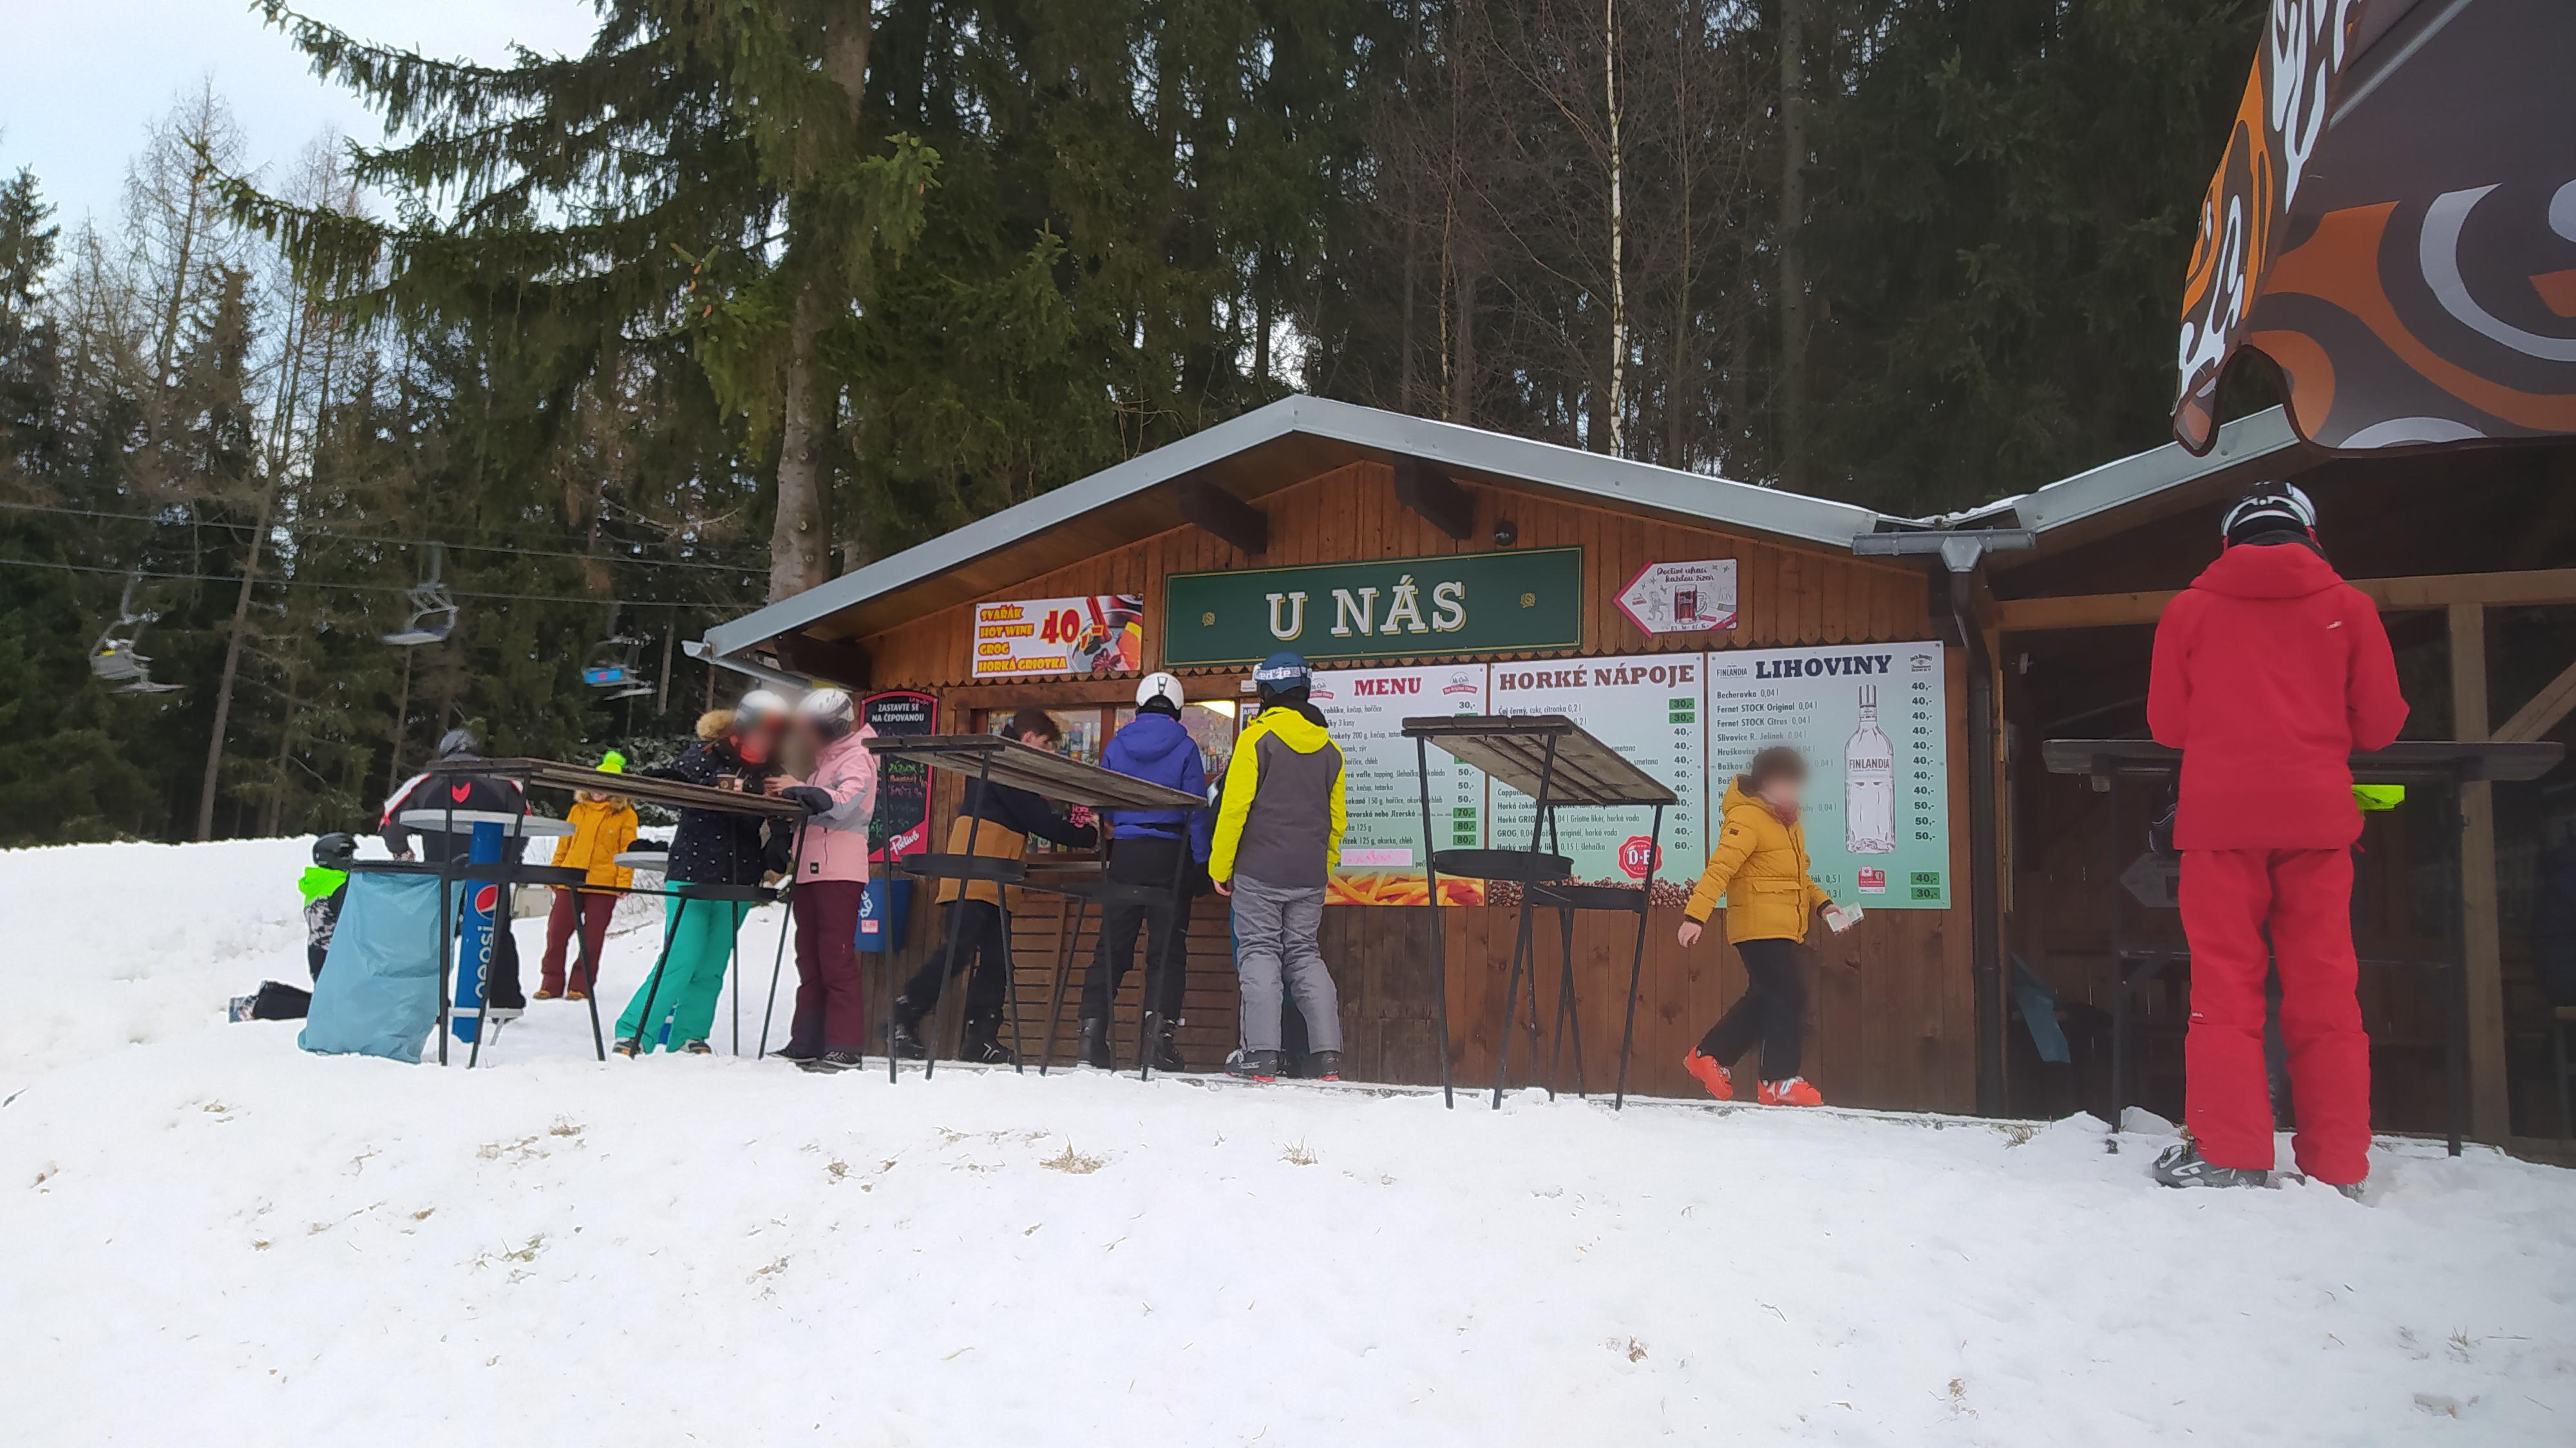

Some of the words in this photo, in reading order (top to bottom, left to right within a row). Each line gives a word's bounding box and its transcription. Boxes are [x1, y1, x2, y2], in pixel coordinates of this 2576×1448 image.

[980, 604, 1024, 621] SVAŘÁK
[1265, 591, 1308, 641] U
[1331, 574, 1467, 638] NÁS
[979, 627, 1003, 639] HOT
[1005, 624, 1034, 638] WINE
[1039, 609, 1103, 651] 40,-
[978, 642, 1010, 656] GROG
[978, 656, 1016, 672] HORKÁ
[1018, 657, 1068, 670] GRIOTKA
[1755, 654, 1892, 680] LIHOVINY
[1499, 664, 1587, 691] HORKÉ
[1594, 662, 1694, 688] NÁPOJE
[1716, 668, 1748, 676] FINLANDIA
[1354, 677, 1422, 696] MENU
[1911, 681, 1932, 692] 40,-
[1717, 689, 1757, 699] Becherovka
[1760, 689, 1775, 698] 0,04
[1459, 701, 1476, 710] 30,-
[1674, 700, 1692, 709] 30,-
[1911, 696, 1932, 707] 40,-
[878, 703, 909, 712] ZASTAVTE
[911, 703, 919, 712] SE
[1544, 704, 1567, 712] citronka
[1567, 703, 1578, 713] 0,2
[1741, 703, 1765, 712] STOCK
[1766, 701, 1795, 713] Original
[1798, 701, 1813, 711] 0,04
[884, 712, 924, 722] ČEPOVANOU
[1674, 714, 1692, 723] 30,-
[1911, 711, 1933, 721] 40,-
[1717, 719, 1739, 728] Fernet
[1741, 718, 1765, 727] STOCK
[1767, 717, 1788, 726] Citrus
[1792, 716, 1806, 726] 0,04
[1674, 728, 1692, 737] 40,-
[1912, 726, 1933, 736] 40,-
[1717, 733, 1748, 742] Slivovice
[1750, 732, 1757, 741] R.
[1788, 731, 1803, 740] 0,04
[1674, 742, 1692, 751] 40,-
[1912, 741, 1933, 751] 40,-
[1717, 747, 1756, 756] Hruškovice
[1365, 756, 1378, 765] chléb
[1674, 756, 1692, 765] 40,-
[1849, 758, 1890, 770] FINLANDIA
[1913, 756, 1934, 766] 40,-
[1718, 762, 1743, 770] Božkov
[1458, 768, 1475, 777] 50,-
[1674, 770, 1692, 779] 40,-
[1913, 770, 1935, 781] 40,-
[1457, 782, 1475, 791] 50,-
[1674, 785, 1692, 794] 40,-
[1913, 786, 1935, 796] 40,-
[1368, 796, 1378, 805] 150
[1407, 796, 1422, 805] okurk
[1497, 801, 1517, 810] Horká
[1914, 801, 1935, 811] 50,-
[1374, 809, 1389, 817] nebo
[1457, 808, 1474, 817] 70,-
[1674, 813, 1693, 822] 40,-
[1497, 815, 1517, 824] Horká
[1519, 815, 1549, 823] GRIOA
[1555, 815, 1565, 824] ,04
[1570, 815, 1589, 823] Griotte
[1607, 814, 1624, 822] horká
[1625, 814, 1640, 822] voda
[1915, 816, 1936, 826] 50,-
[1356, 823, 1367, 832] 125
[1457, 822, 1475, 831] 80,-
[1674, 827, 1693, 836] 40,-
[1585, 828, 1602, 836] horká
[1604, 828, 1618, 836] voda
[1915, 832, 1936, 842] 50,-
[1359, 837, 1370, 845] 125
[1399, 836, 1413, 844] chléb
[1457, 835, 1474, 844] 80,-
[1560, 843, 1574, 851] 0,15
[1580, 842, 1605, 850] šlehačka
[1674, 841, 1694, 850] 60,-
[1826, 875, 1837, 884] 0,5
[1916, 874, 1938, 884] 40,-
[1917, 889, 1938, 899] 30,-
